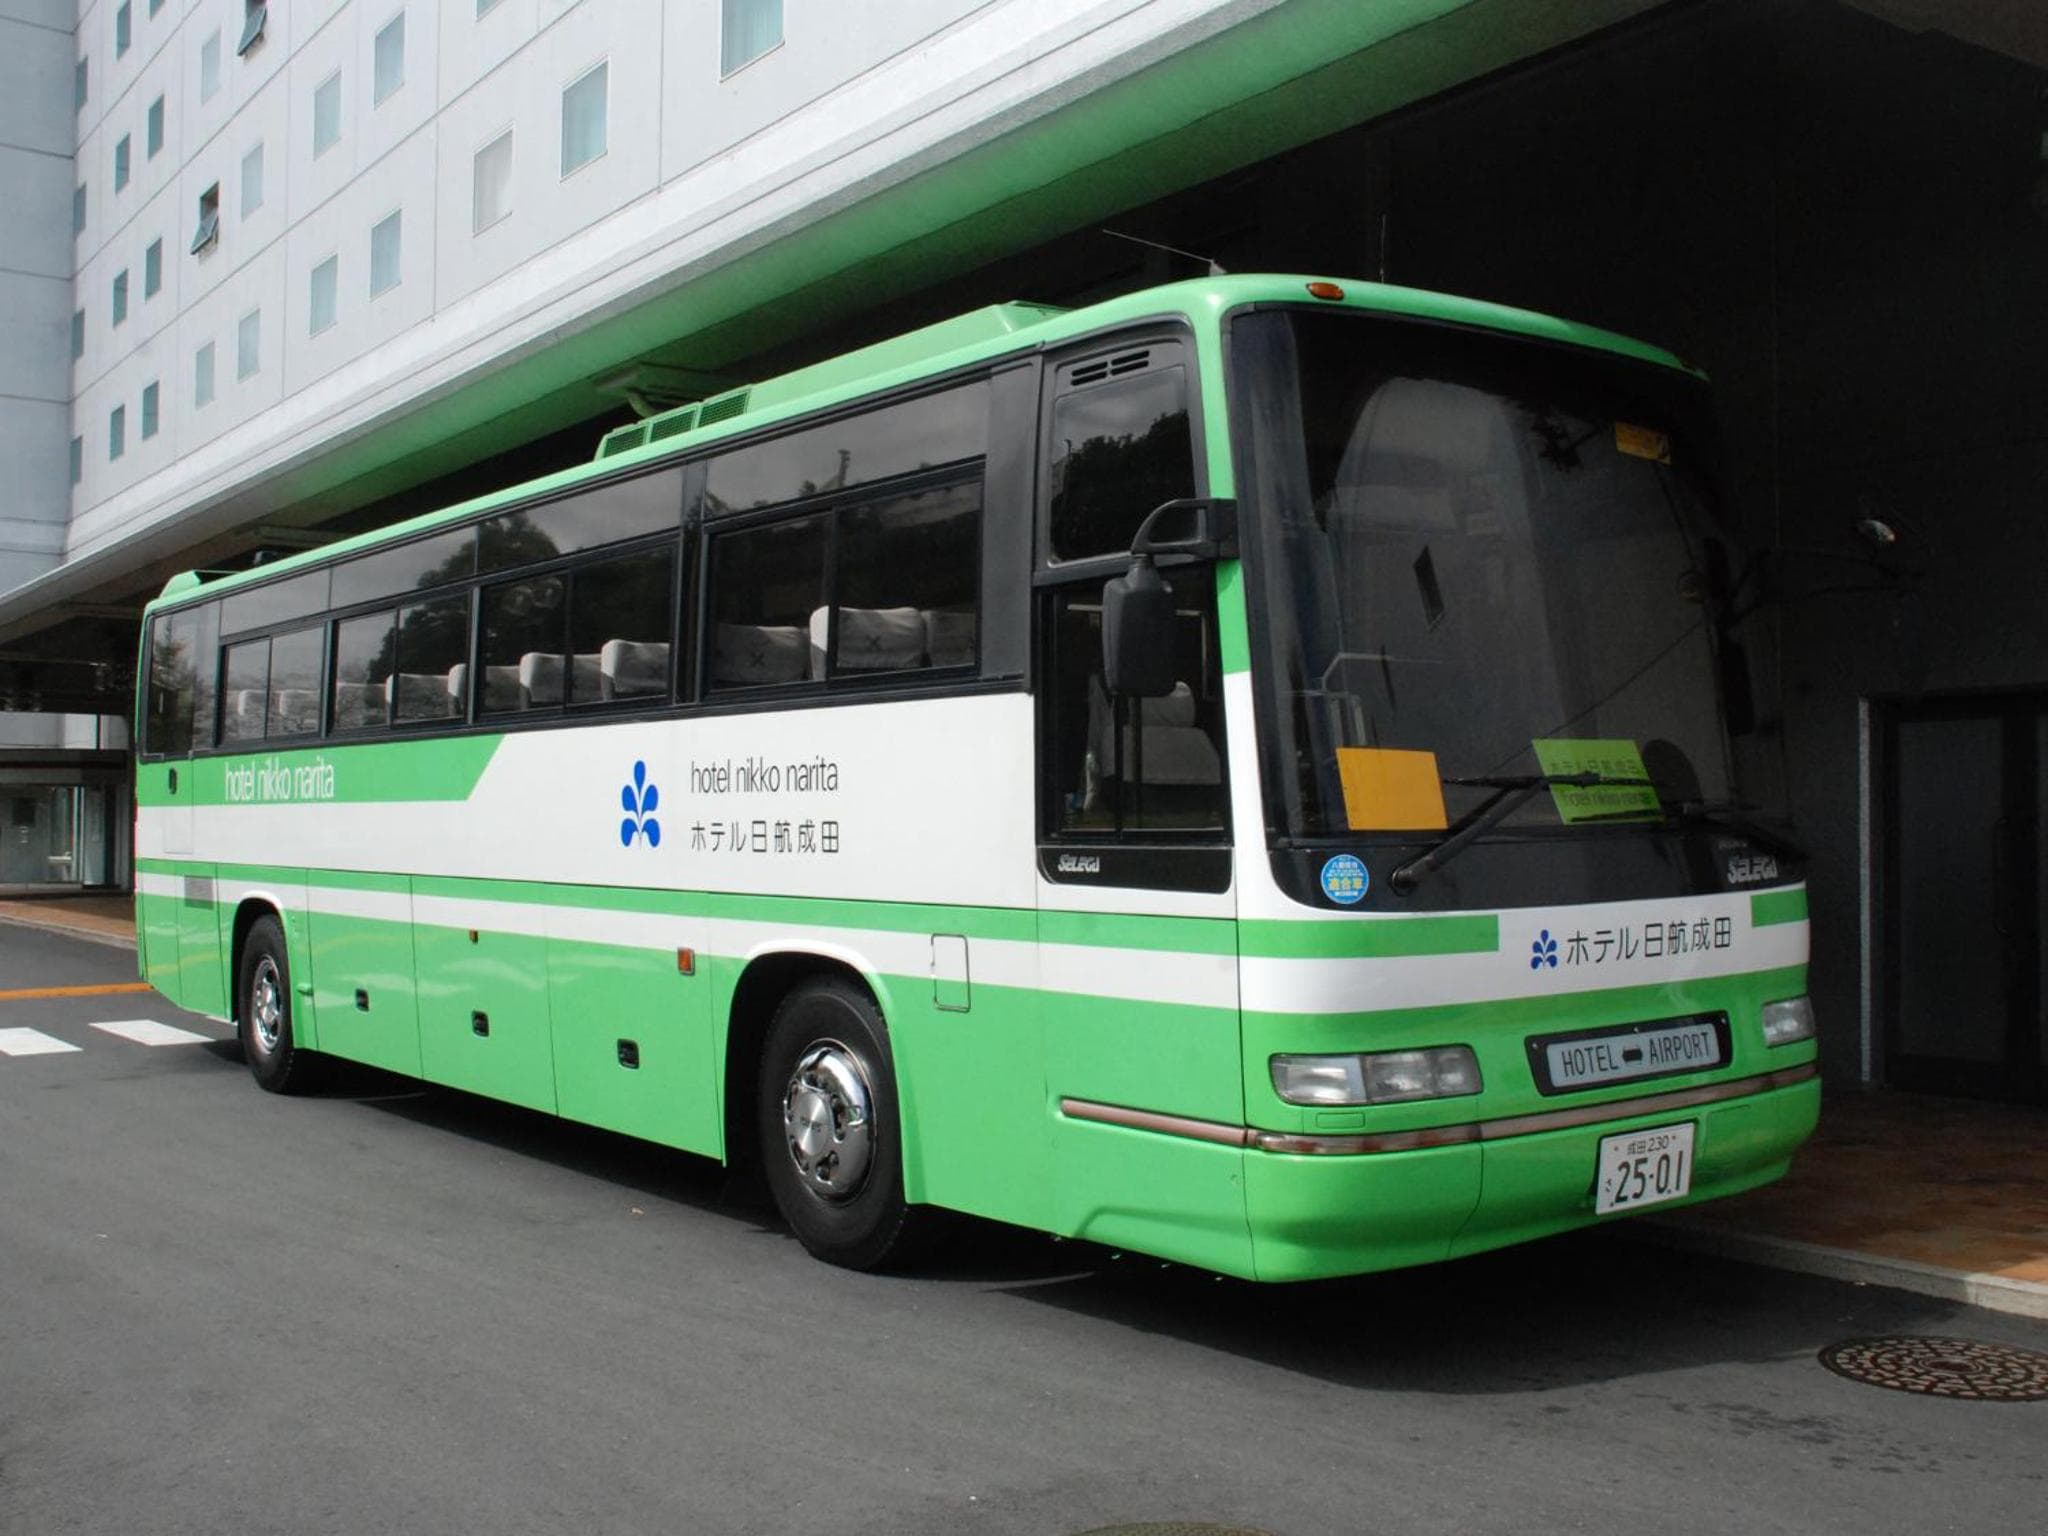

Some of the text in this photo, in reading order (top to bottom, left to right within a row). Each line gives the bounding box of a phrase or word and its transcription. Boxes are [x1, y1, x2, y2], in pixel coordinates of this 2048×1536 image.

[224, 755, 334, 802] hotel nikko narita
[691, 755, 838, 794] hotel nikko narita
[691, 819, 839, 853] ホテル日航成田
[1566, 917, 1731, 965] ホテル日航成田
[1561, 1032, 1709, 1077] HOTEL AIRPORT
